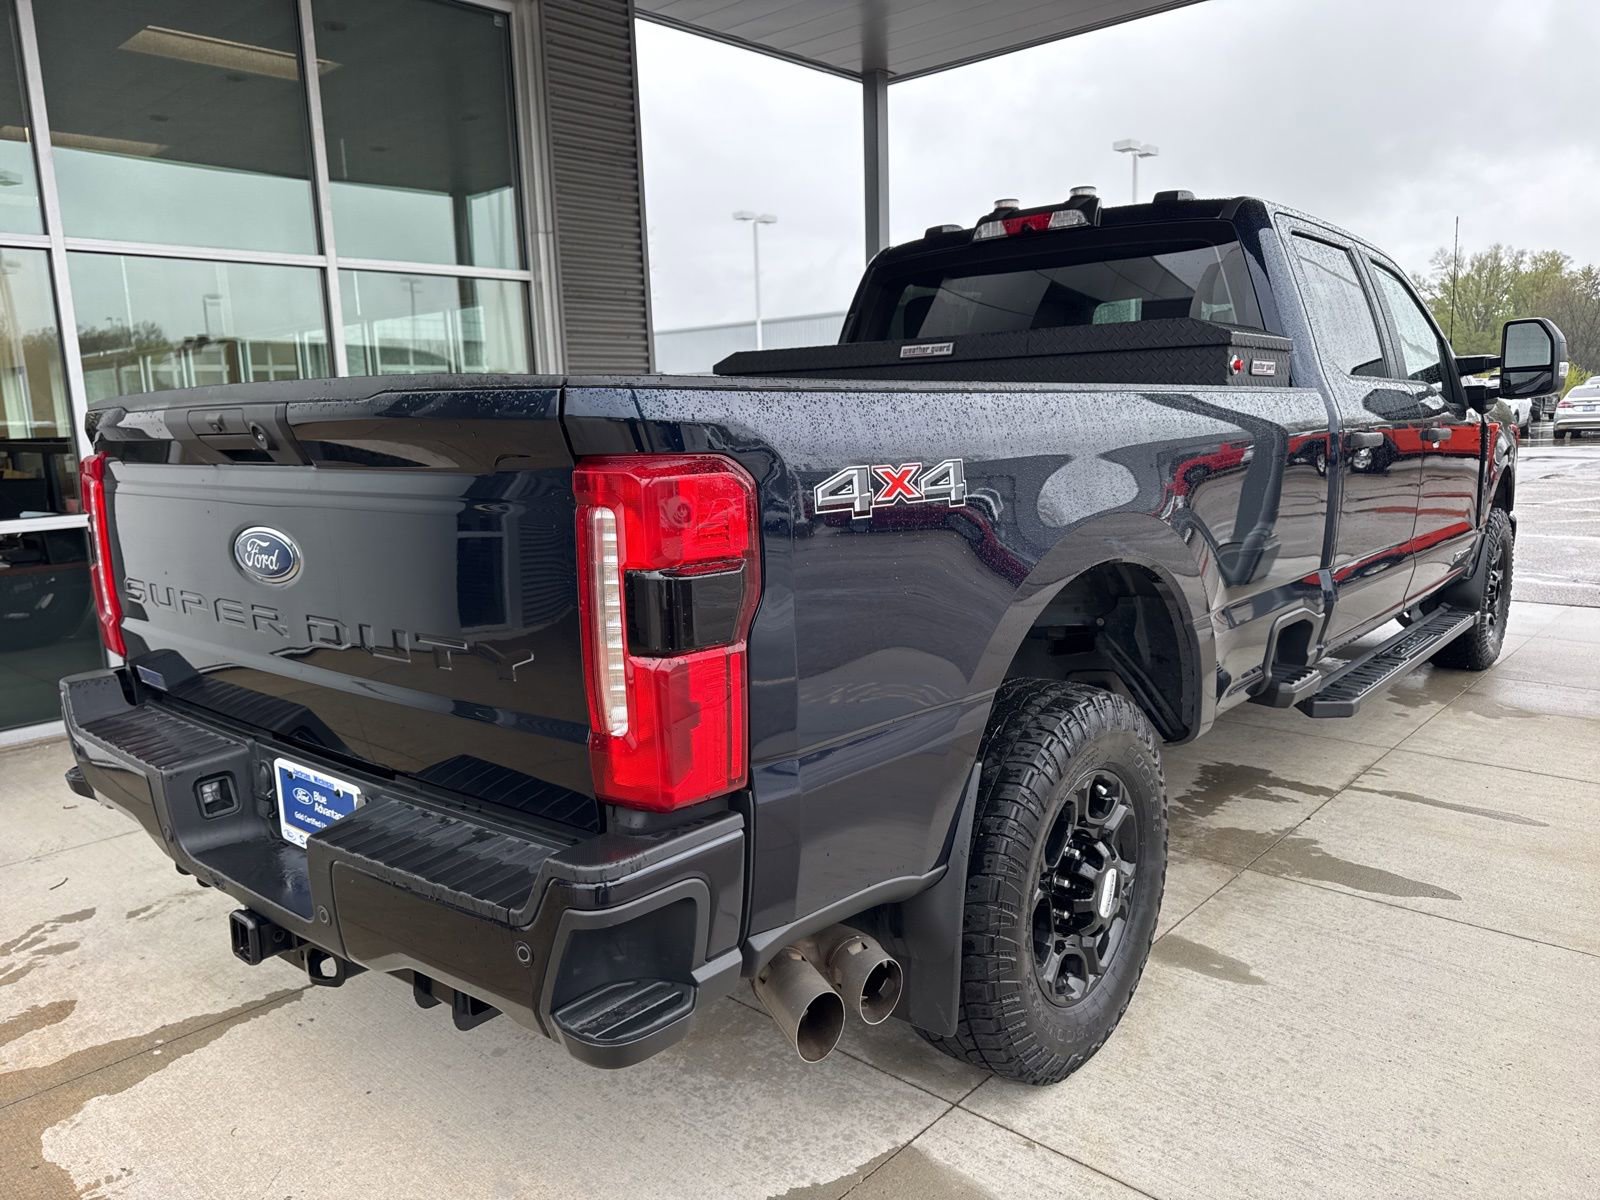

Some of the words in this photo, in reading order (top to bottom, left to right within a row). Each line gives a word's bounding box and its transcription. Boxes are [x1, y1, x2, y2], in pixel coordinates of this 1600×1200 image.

[244, 538, 280, 570] Ford
[124, 577, 290, 639] SUPER
[305, 614, 535, 682] DUTY
[313, 790, 327, 805] Blue
